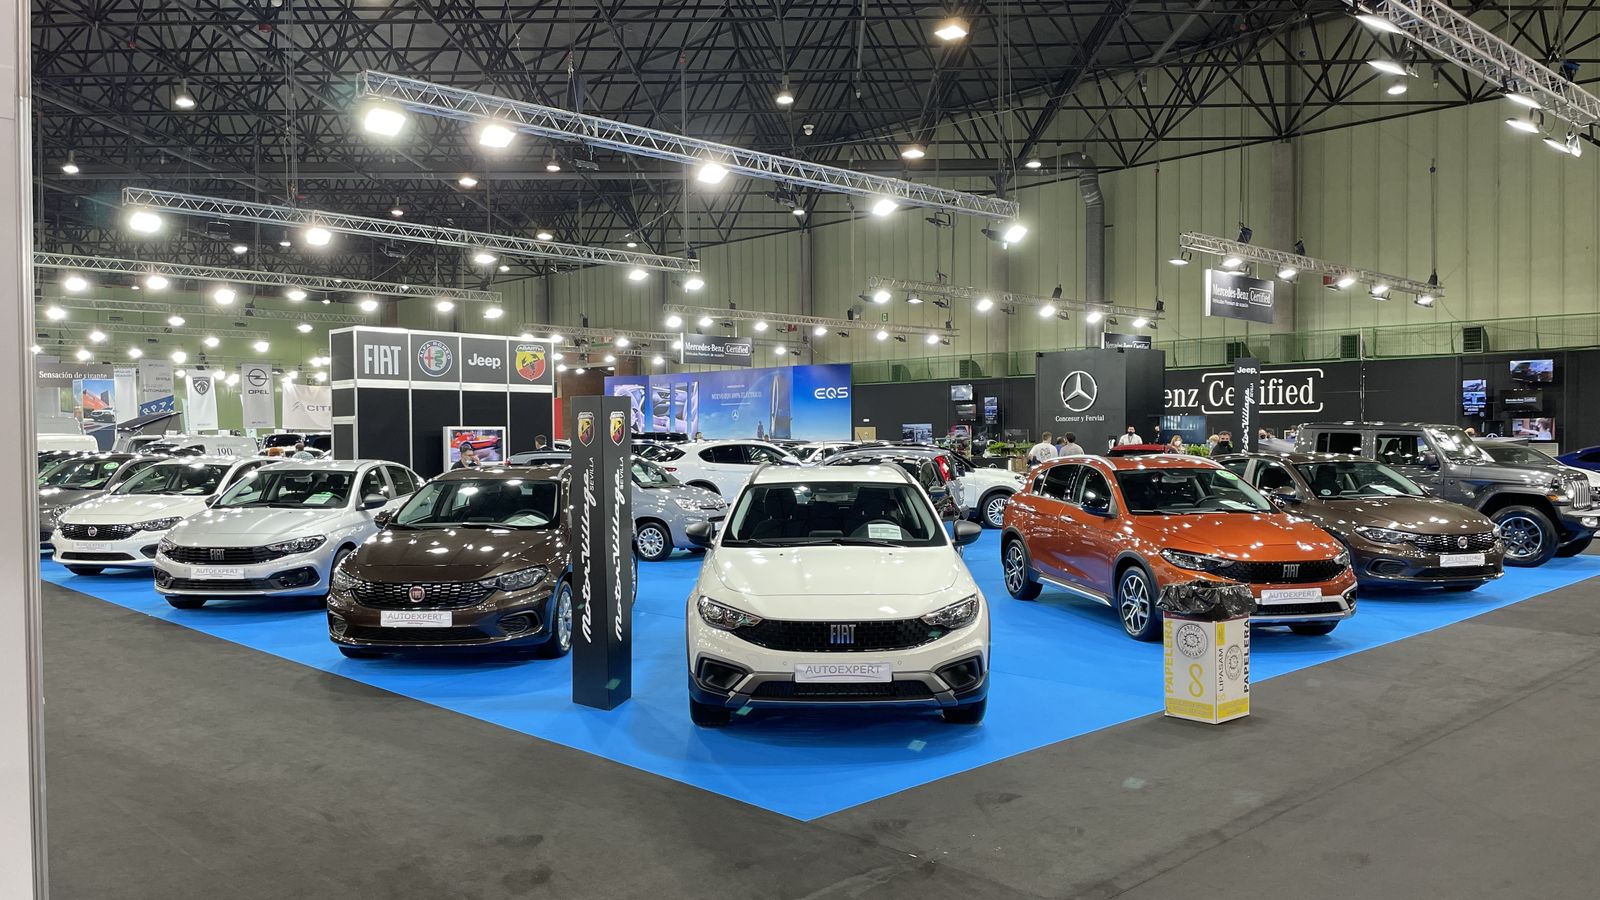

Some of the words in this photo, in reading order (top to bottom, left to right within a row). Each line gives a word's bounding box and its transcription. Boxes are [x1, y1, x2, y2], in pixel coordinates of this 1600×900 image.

[685, 342, 724, 353] Mercedes-Benz
[726, 345, 749, 354] Certified
[364, 344, 401, 375] FIAT
[468, 353, 501, 369] Jeep
[39, 371, 73, 379] Sensación
[1236, 366, 1257, 374] Jeep
[814, 387, 849, 400] EQS
[1209, 377, 1315, 407] Ceified
[210, 548, 225, 561] FIAT
[1282, 563, 1301, 578] FIAT
[1267, 590, 1316, 600] AUTOEXPERT
[387, 613, 443, 621] AUTOEXPERT
[829, 623, 857, 644] FIAT
[1165, 620, 1174, 694] PAPELERA
[805, 664, 882, 674] AUTOEXPERT
